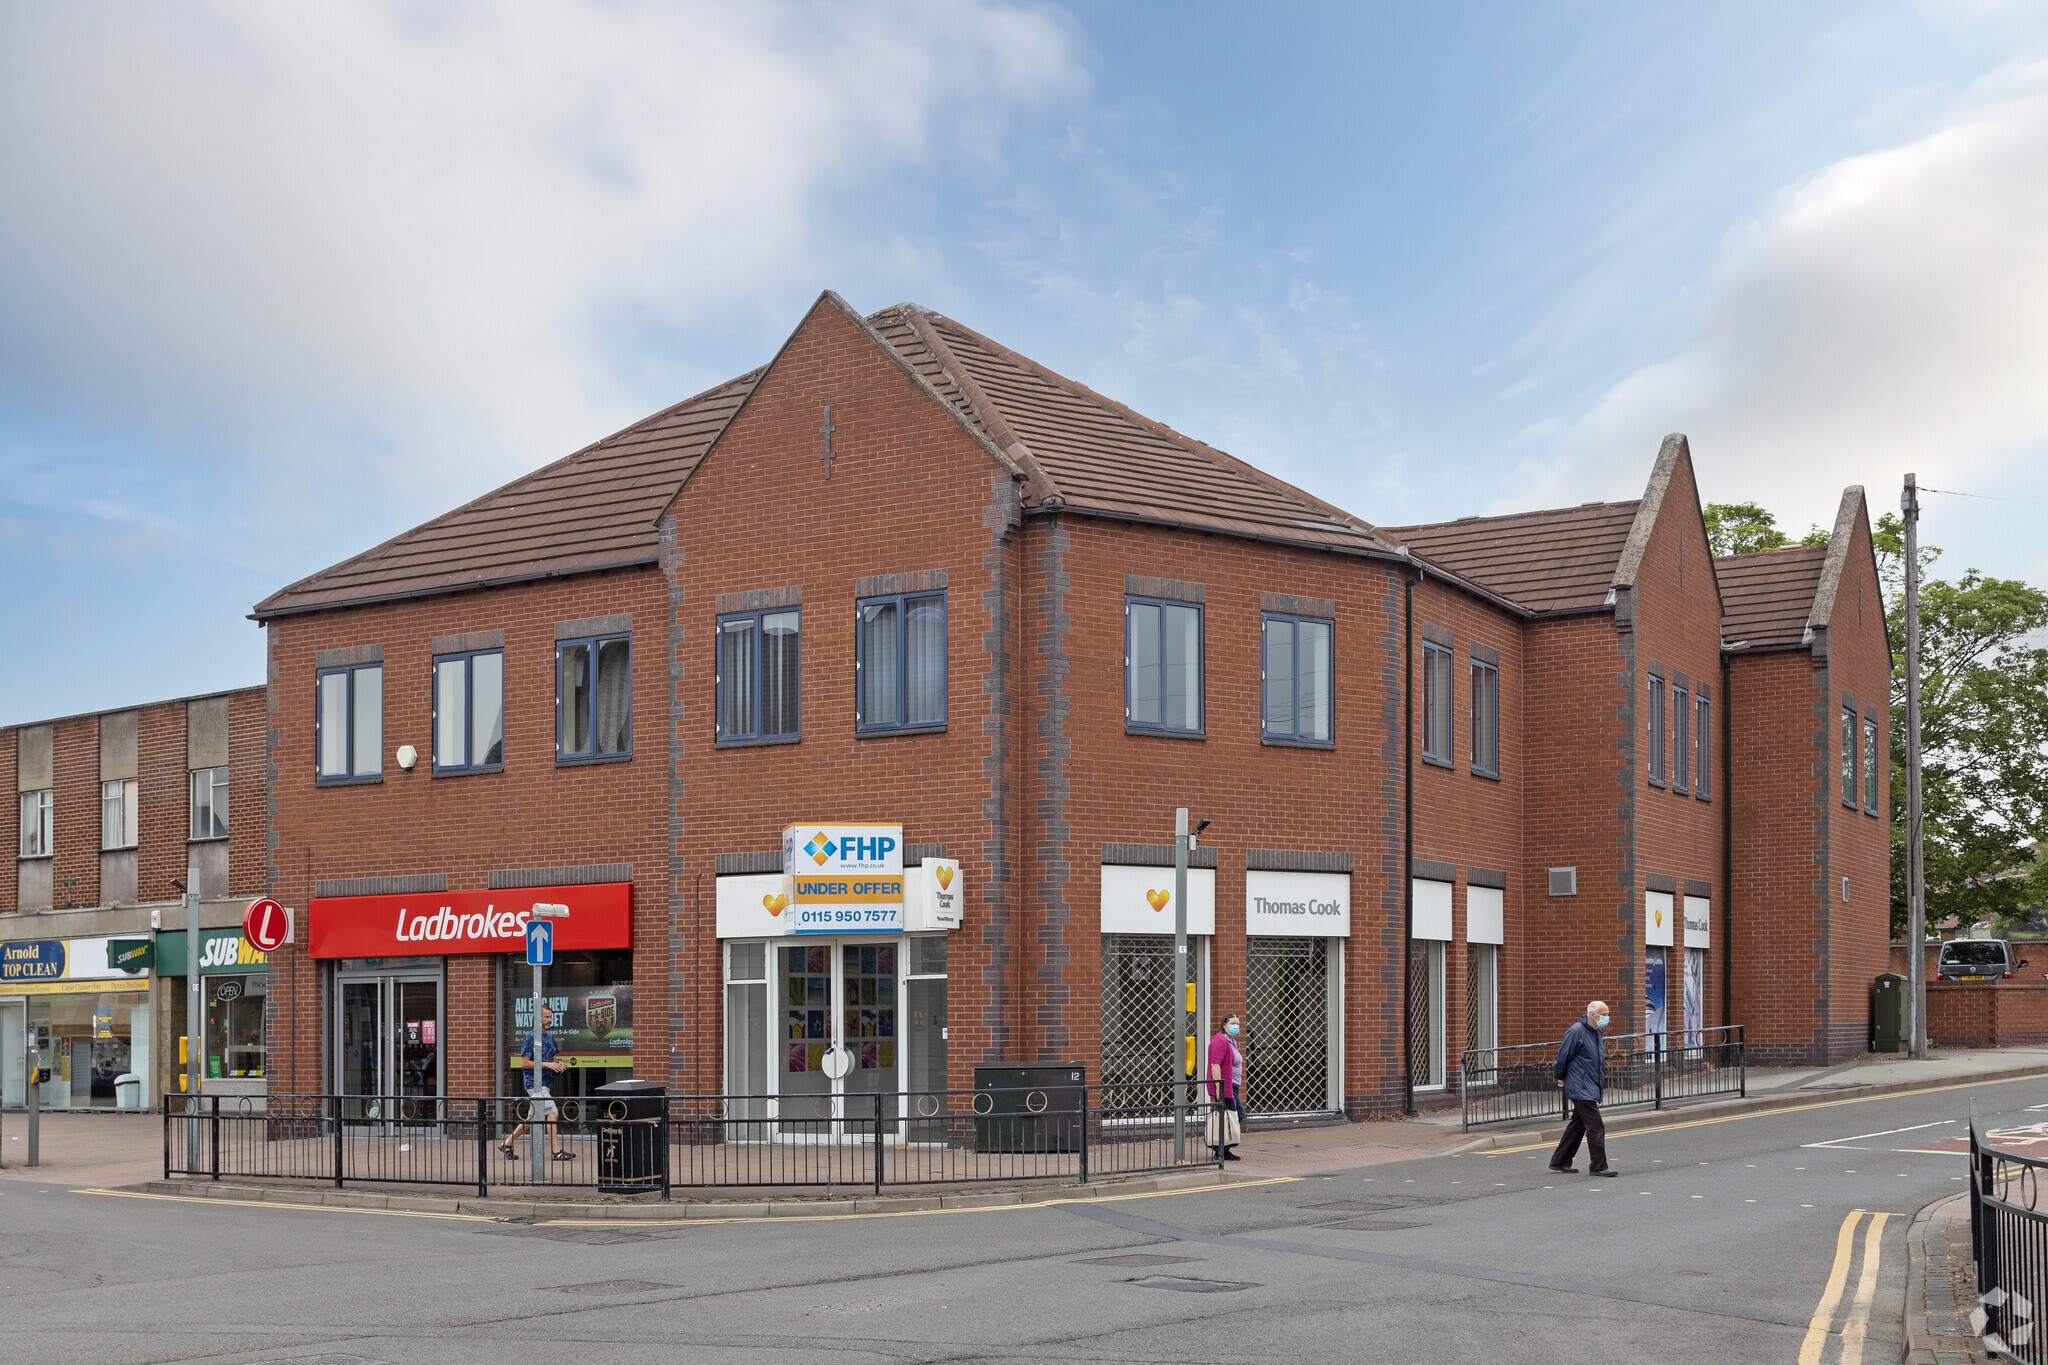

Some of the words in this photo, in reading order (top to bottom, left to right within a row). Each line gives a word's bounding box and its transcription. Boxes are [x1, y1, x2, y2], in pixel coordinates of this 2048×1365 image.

[840, 836, 896, 861] FHP
[797, 882, 848, 895] UNDER
[853, 882, 901, 894] OFFER
[1253, 897, 1306, 915] Thomas
[1308, 898, 1342, 916] Cook
[395, 904, 531, 942] Ladbrokes
[801, 910, 832, 923] 0115
[835, 910, 862, 922] 950
[864, 909, 897, 922] 7577
[257, 906, 276, 946] L
[4, 944, 40, 961] Arnold
[117, 945, 149, 964] SUBWAY
[2, 963, 22, 977] TOP
[22, 961, 58, 976] CLEAN
[219, 985, 239, 997] OPEN
[515, 997, 527, 1013] AN
[549, 996, 569, 1012] NEW
[1071, 1071, 1080, 1081] 12
